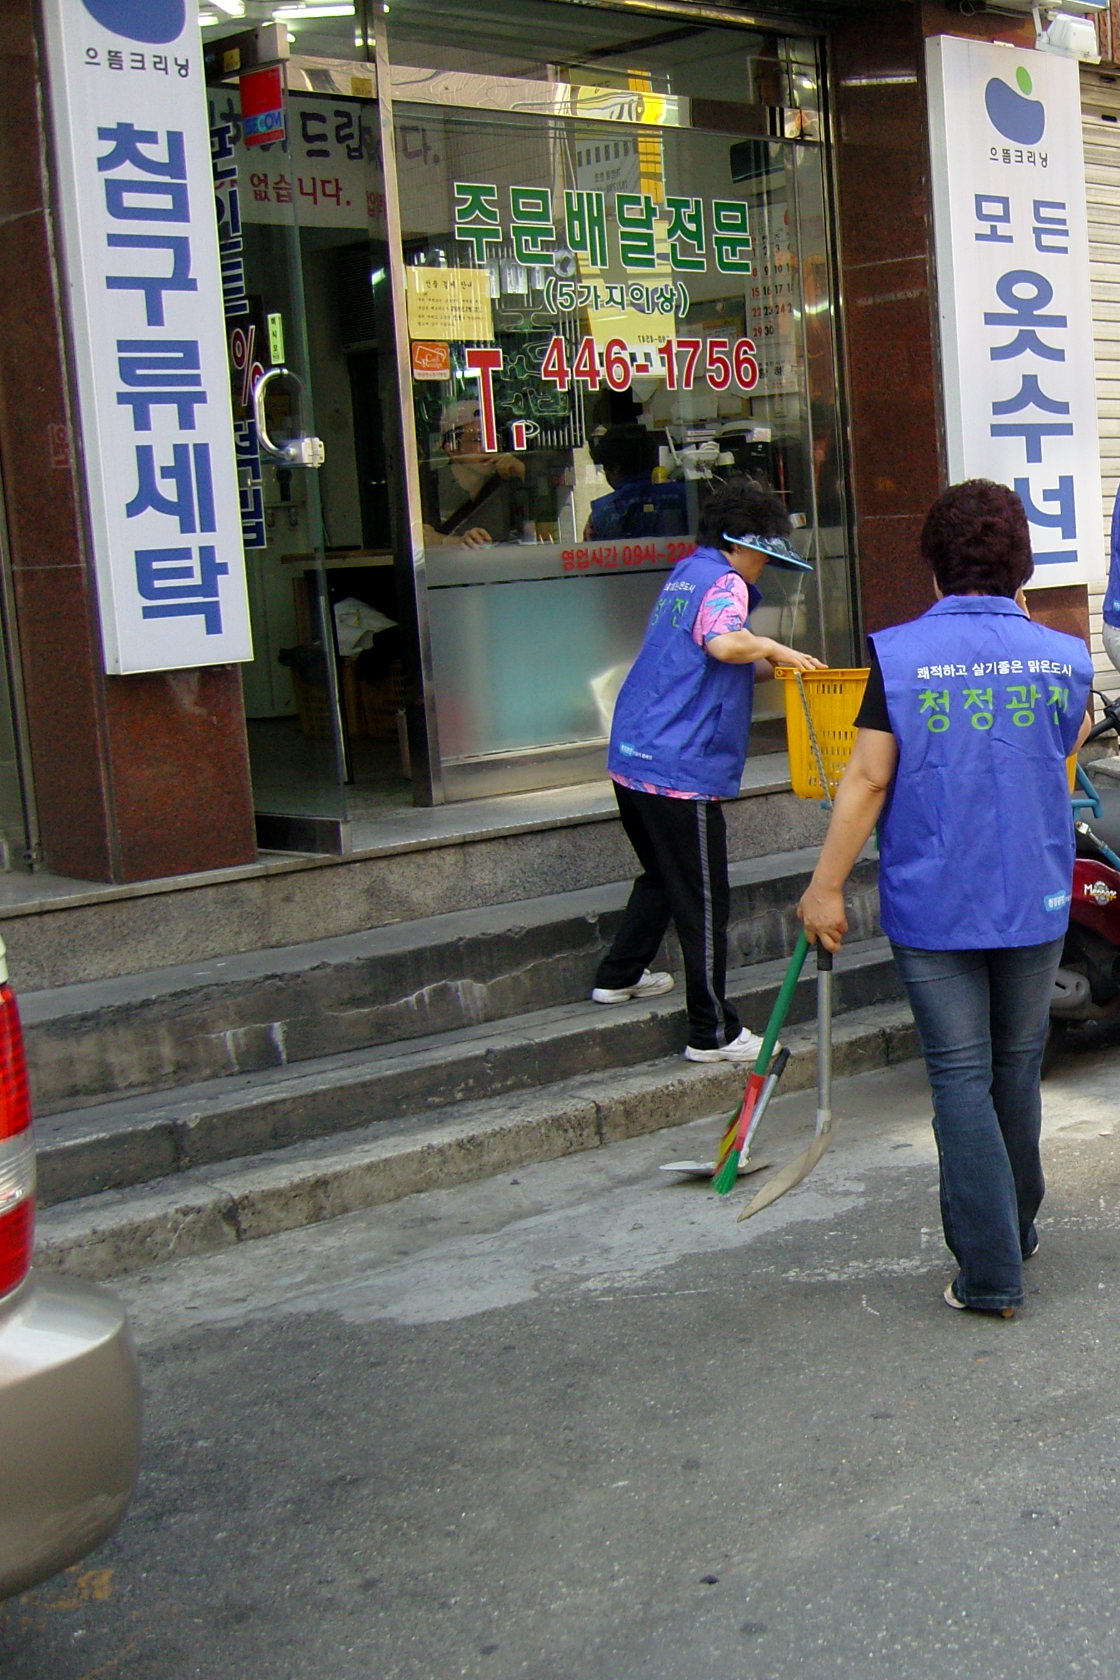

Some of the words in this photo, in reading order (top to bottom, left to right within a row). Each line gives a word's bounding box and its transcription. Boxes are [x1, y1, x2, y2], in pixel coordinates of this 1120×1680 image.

[84, 47, 190, 78] 으뜸크리닝
[989, 147, 1048, 169] 으뜸크리닝
[250, 171, 352, 208] 없습니다.
[453, 181, 753, 274] 주문배달전문
[974, 193, 1070, 255] 모든
[543, 277, 691, 319] (5가지이상)
[752, 287, 761, 298] 15
[774, 284, 783, 296] 17
[752, 307, 762, 318] 22
[752, 326, 763, 338] 29
[764, 325, 775, 337] 30
[97, 122, 229, 635] 침구류세탁
[541, 335, 760, 393] 446-1756
[984, 269, 1079, 566] 옷수선
[561, 546, 619, 572] 영업시간
[917, 663, 966, 680] 쾌적하고
[972, 660, 1023, 677] 살기좋은
[1028, 659, 1072, 678] 맑은도시
[919, 684, 1071, 734] 청정광진
